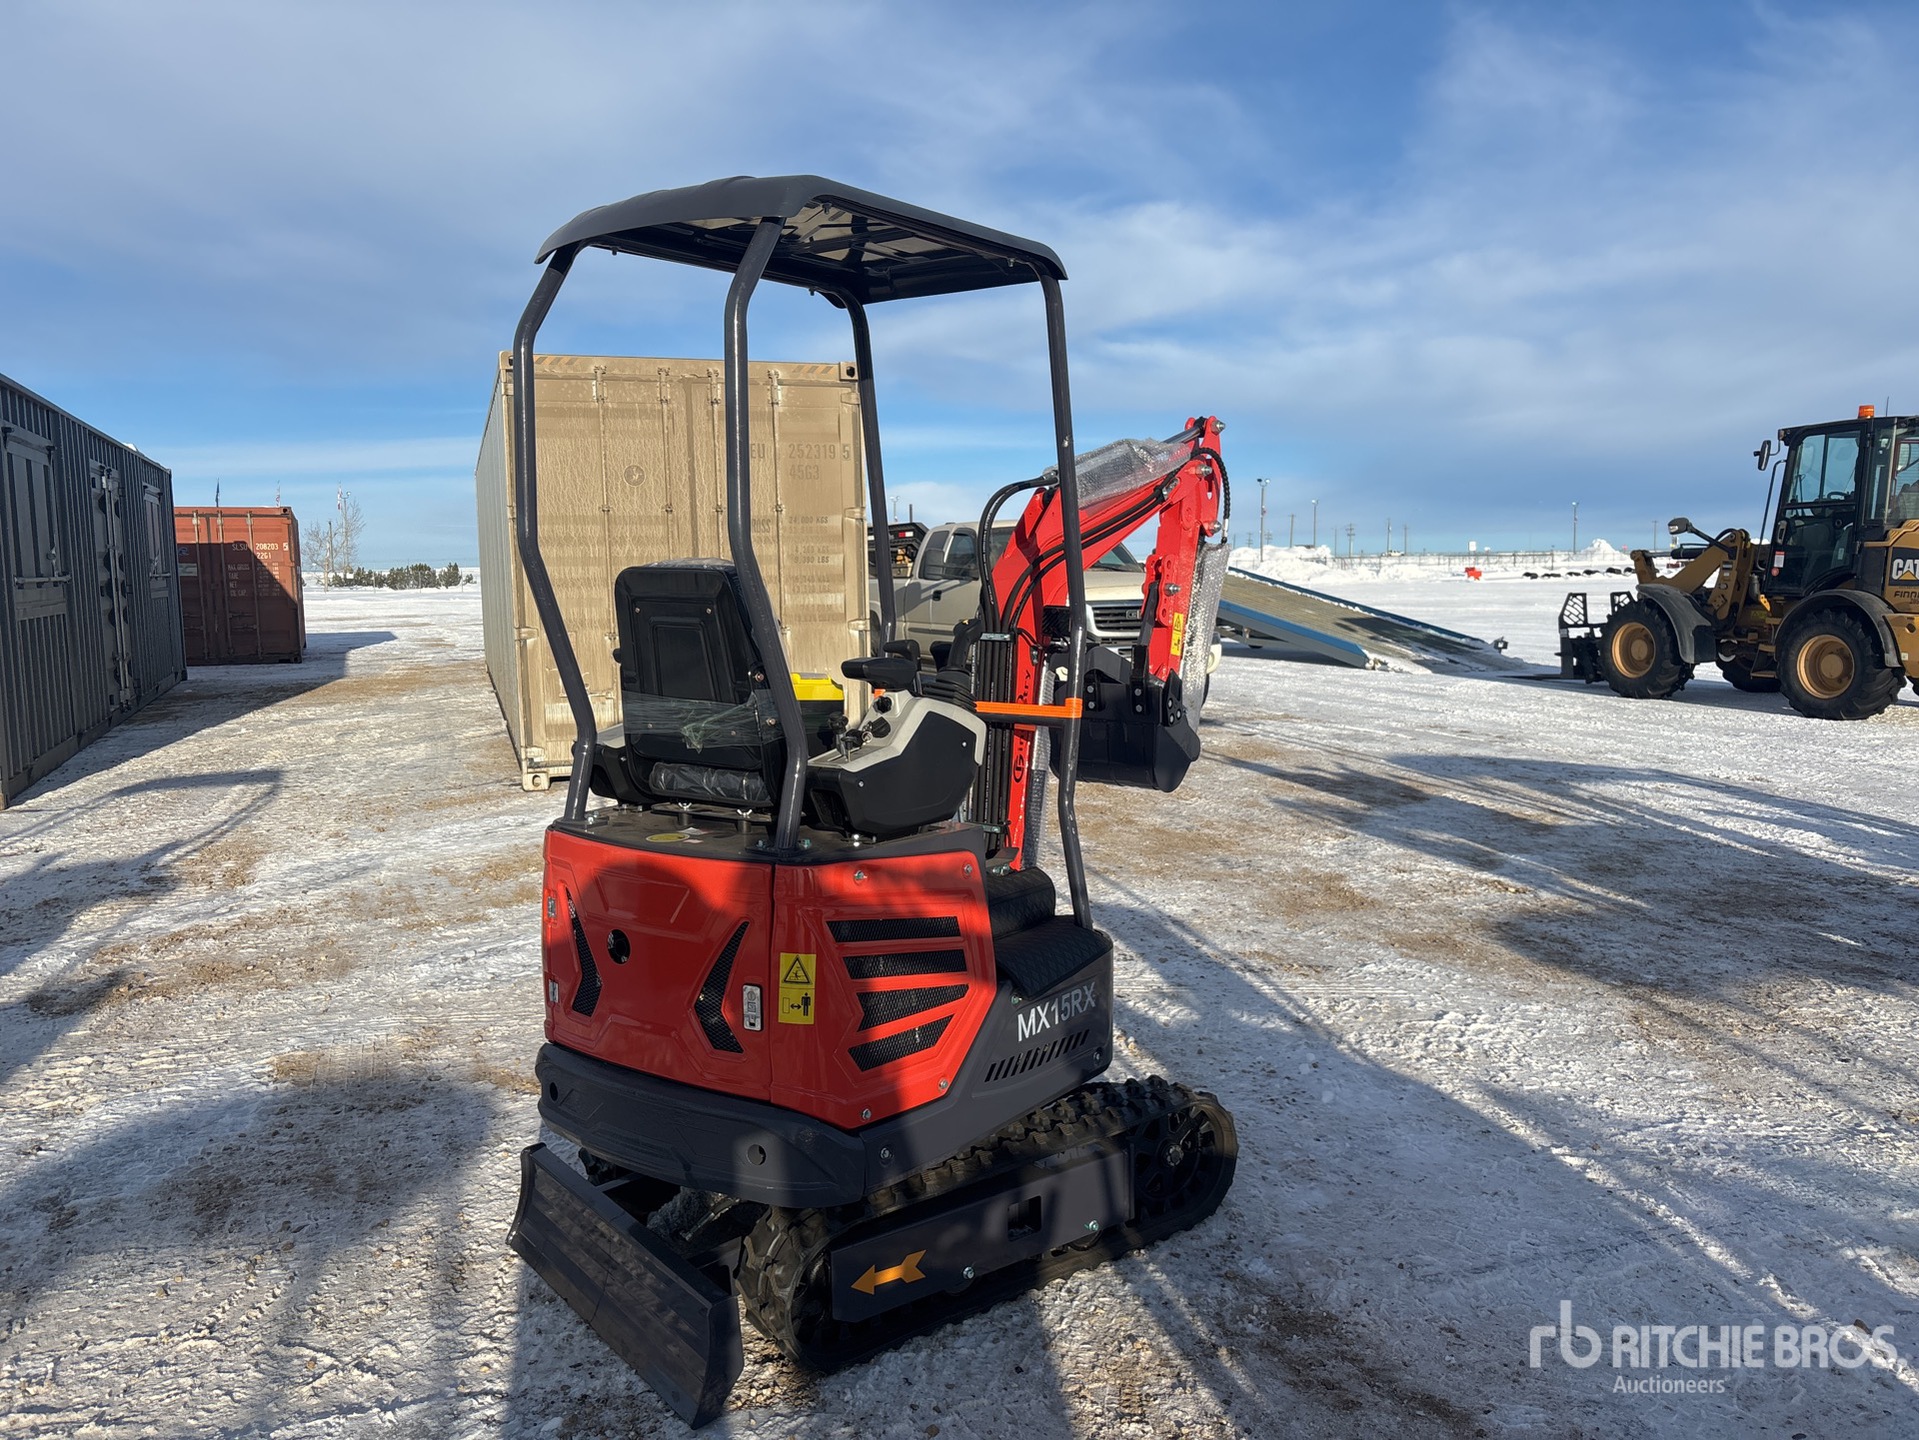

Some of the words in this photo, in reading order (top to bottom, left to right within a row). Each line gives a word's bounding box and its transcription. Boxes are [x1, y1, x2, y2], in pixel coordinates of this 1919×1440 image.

[788, 443, 836, 460] 252319
[842, 444, 850, 460] 5
[789, 464, 820, 480] 45G3
[752, 519, 771, 533] ROSS
[255, 543, 279, 551] 208203
[1018, 982, 1096, 1042] MX15RX
